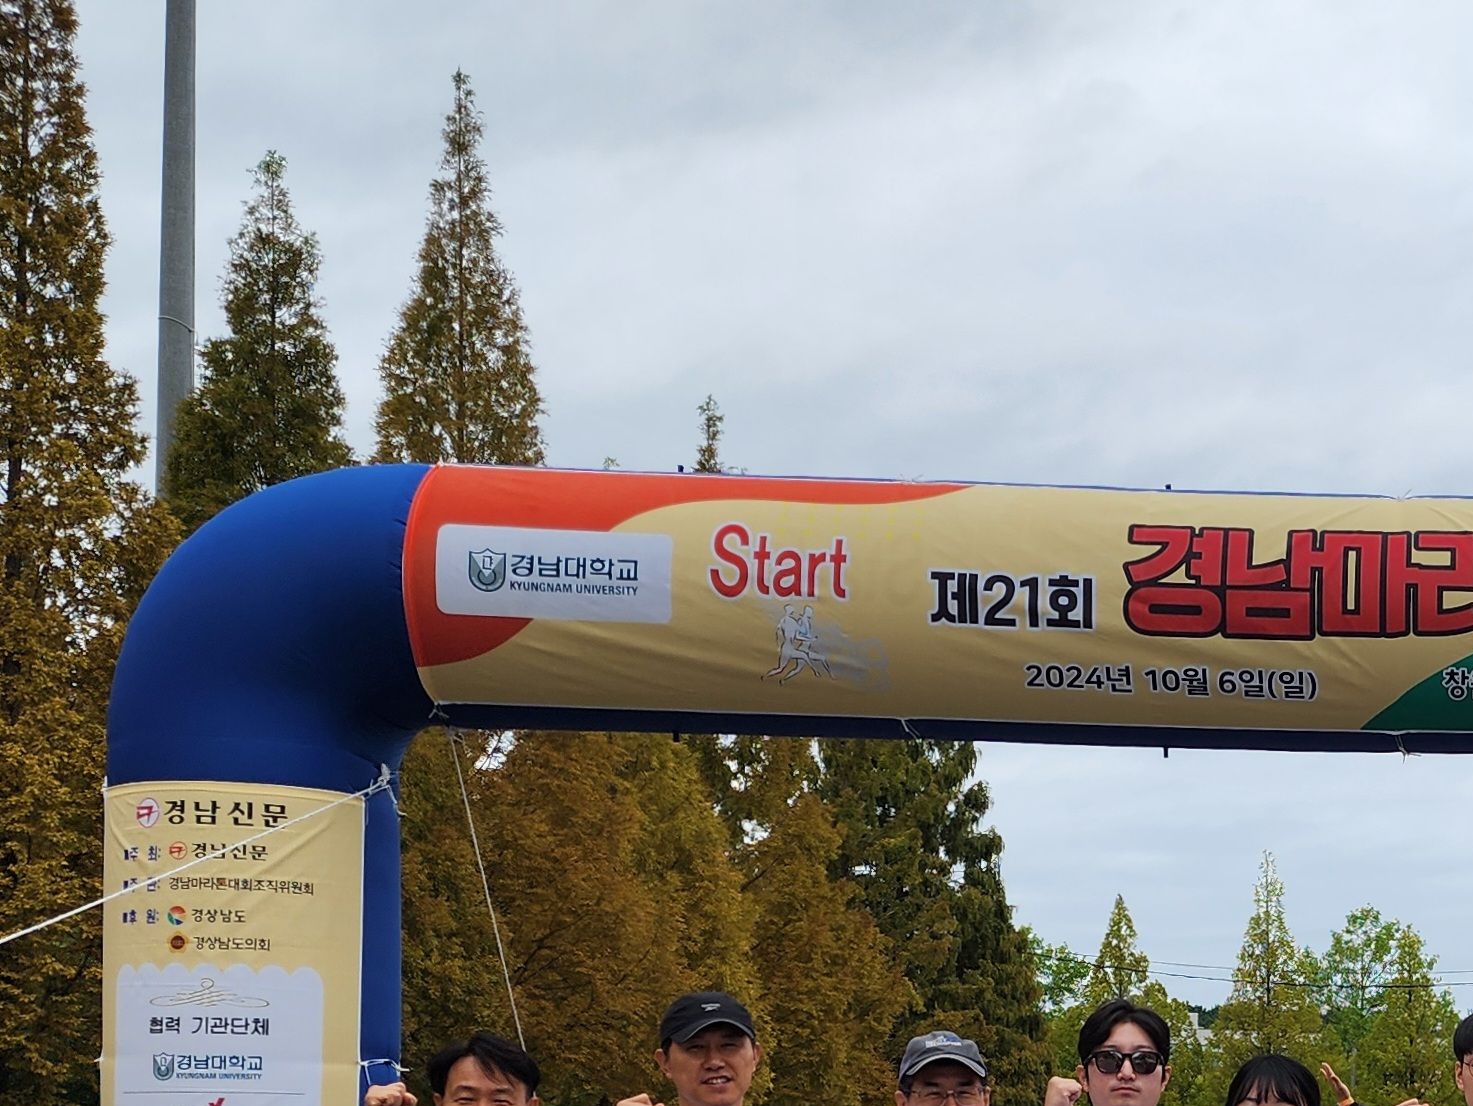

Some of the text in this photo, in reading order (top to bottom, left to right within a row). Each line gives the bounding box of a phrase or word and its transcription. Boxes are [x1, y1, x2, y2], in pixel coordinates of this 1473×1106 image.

[510, 552, 639, 581] 경남대학교
[710, 524, 847, 599] Start
[510, 581, 638, 596] KYUNGNAM UNIVERSITY
[930, 571, 1093, 629] 제21회
[1026, 664, 1318, 700] 2024년 10월 6일(일)
[164, 800, 289, 828] 경남신문
[192, 843, 268, 861] 경남신문
[169, 876, 314, 895] 경남마라톤대회조직위원회
[191, 908, 246, 924] 경상남도
[193, 935, 270, 951] 경상남도의회
[149, 1017, 269, 1036] 협력 기관단체
[177, 1055, 263, 1071] 경남대학교
